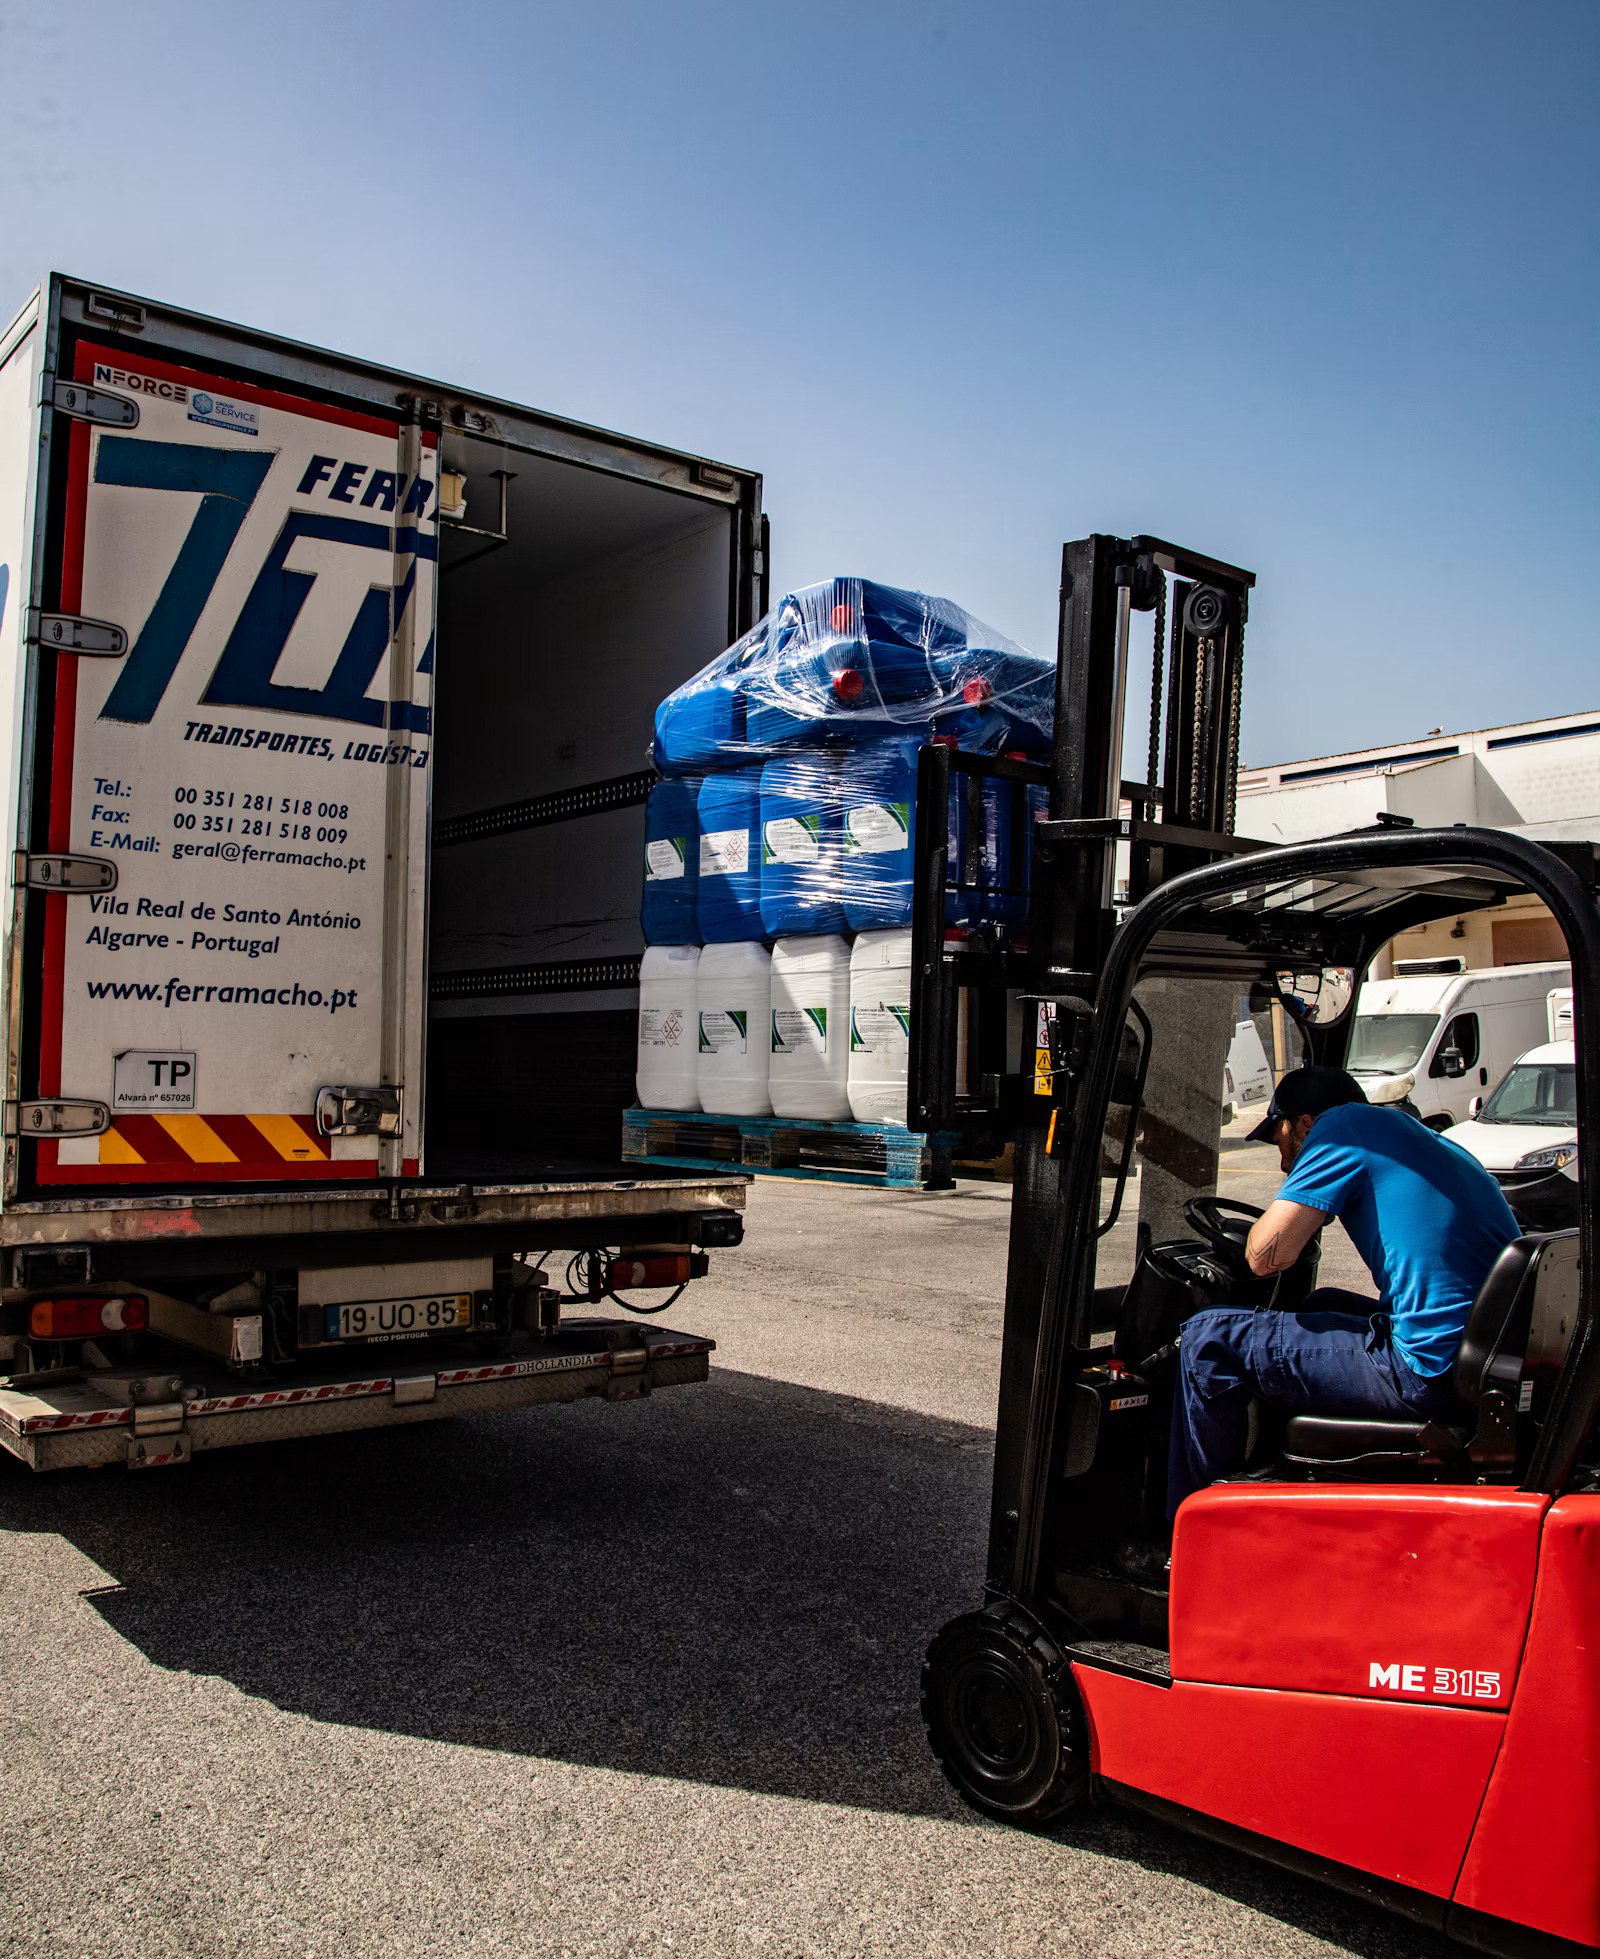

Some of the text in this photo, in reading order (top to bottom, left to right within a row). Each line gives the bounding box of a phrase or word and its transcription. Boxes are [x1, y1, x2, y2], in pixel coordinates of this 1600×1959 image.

[215, 400, 235, 409] GROUP
[215, 405, 257, 423] SERVICE
[94, 777, 133, 798] Tel.:
[91, 804, 130, 824] Fax:
[174, 787, 349, 820] 00 351 281 518 008
[173, 813, 348, 844] 00 351 281 518 009
[90, 831, 367, 872] E-Mail: geral@ferramacho.pt
[89, 895, 361, 930] Vila Real de Santo António
[85, 926, 169, 951] Algarve
[191, 932, 280, 958] Portugal
[87, 978, 358, 1014] www.ferramacho.pt
[147, 1060, 191, 1087] TP
[118, 1093, 147, 1102] Alvará
[160, 1094, 191, 1102] 657026
[367, 1331, 430, 1343] IVECO PORTUGAL
[517, 1355, 594, 1374] DHOLLANDIA
[1368, 1661, 1501, 1699] ME 315
